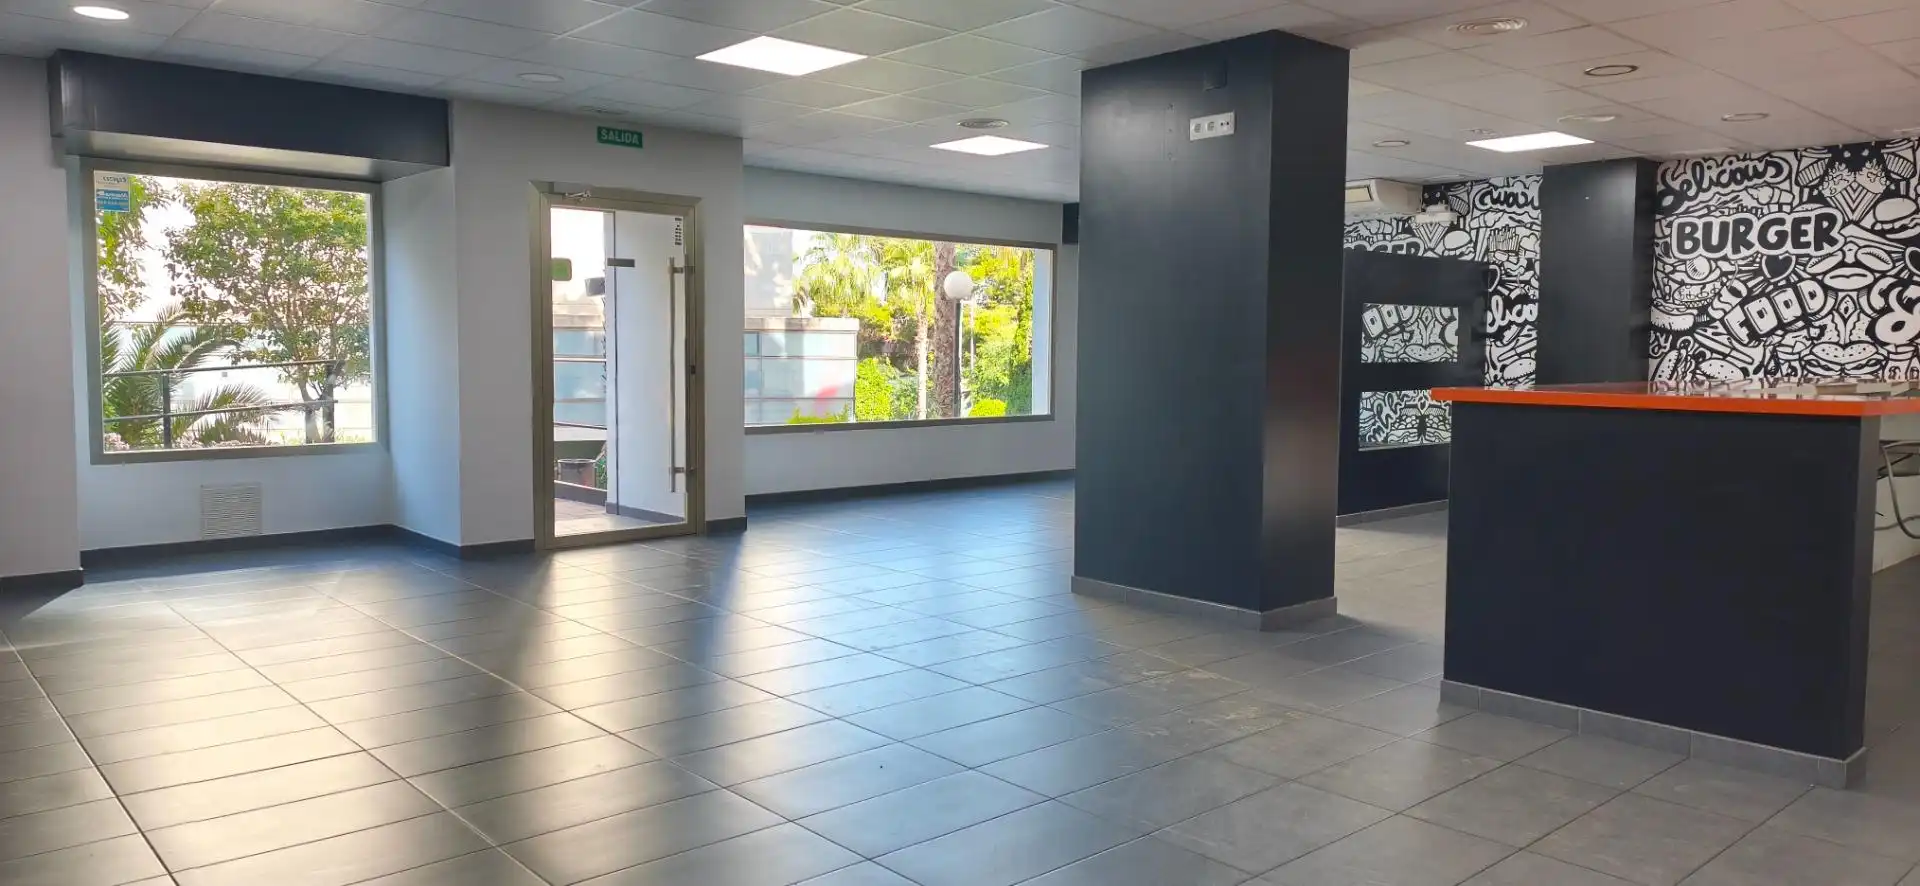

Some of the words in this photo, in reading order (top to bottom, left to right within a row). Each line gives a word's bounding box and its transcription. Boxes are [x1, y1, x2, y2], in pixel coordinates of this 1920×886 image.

[601, 129, 639, 145] SALIDA
[1676, 212, 1840, 255] BURGER
[1724, 279, 1826, 344] FOOD
